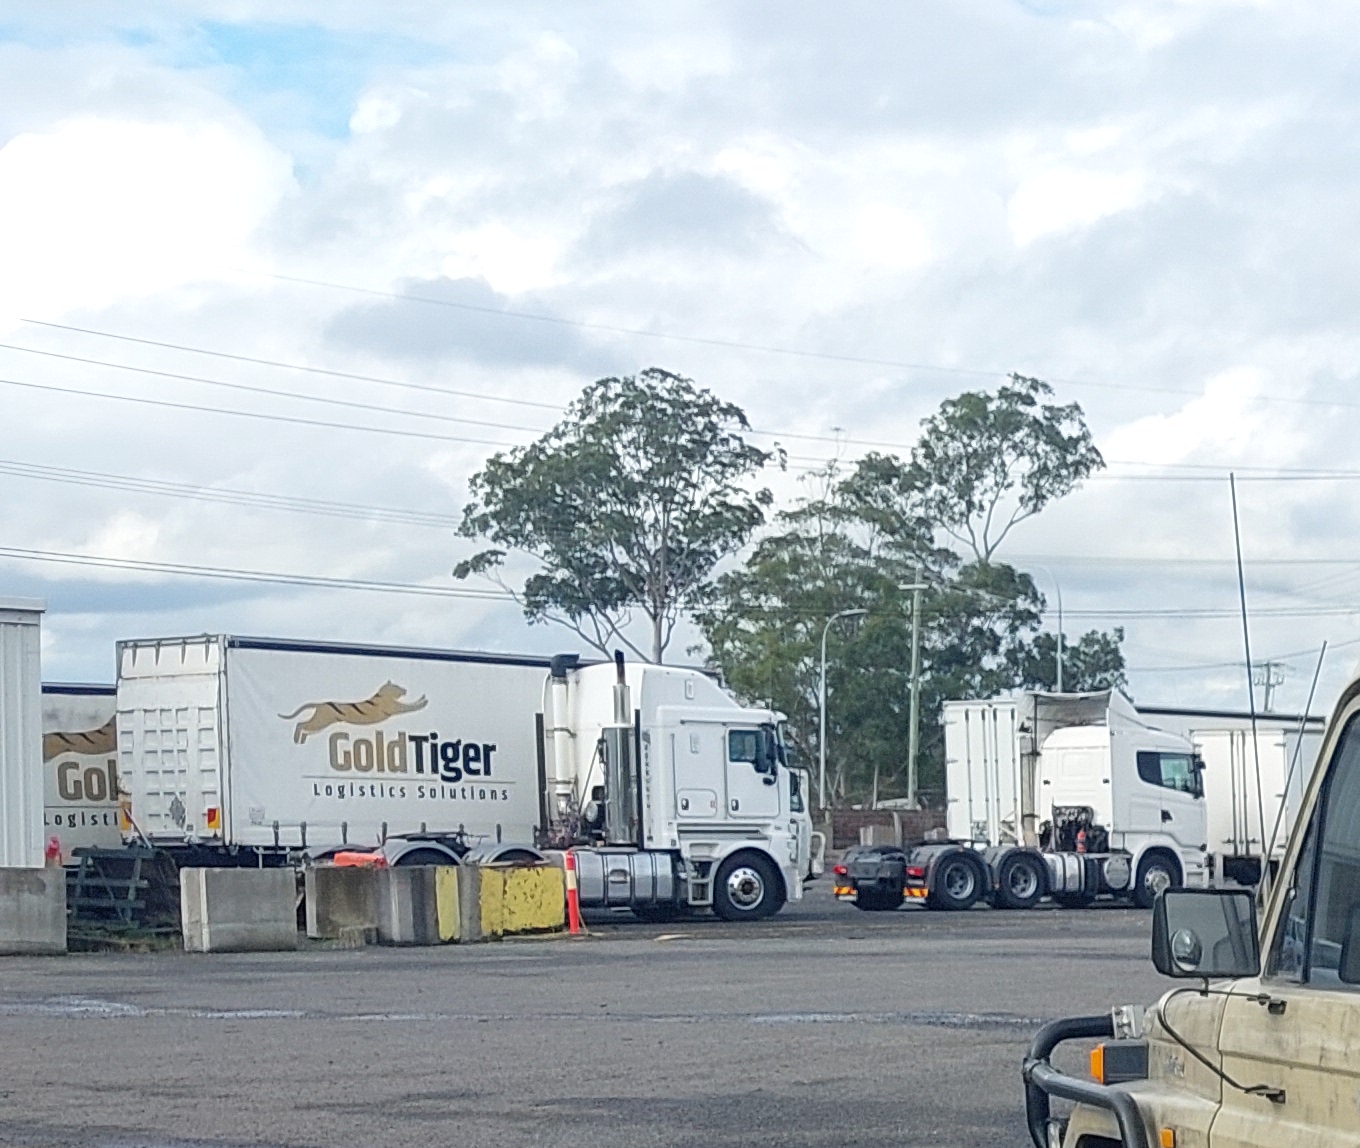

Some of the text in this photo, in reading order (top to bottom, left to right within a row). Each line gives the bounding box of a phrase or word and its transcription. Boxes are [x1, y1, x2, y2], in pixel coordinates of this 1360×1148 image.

[328, 730, 497, 783] GoldTiger
[313, 783, 509, 801] Logistics Solutions
[44, 811, 118, 828] Logisti
